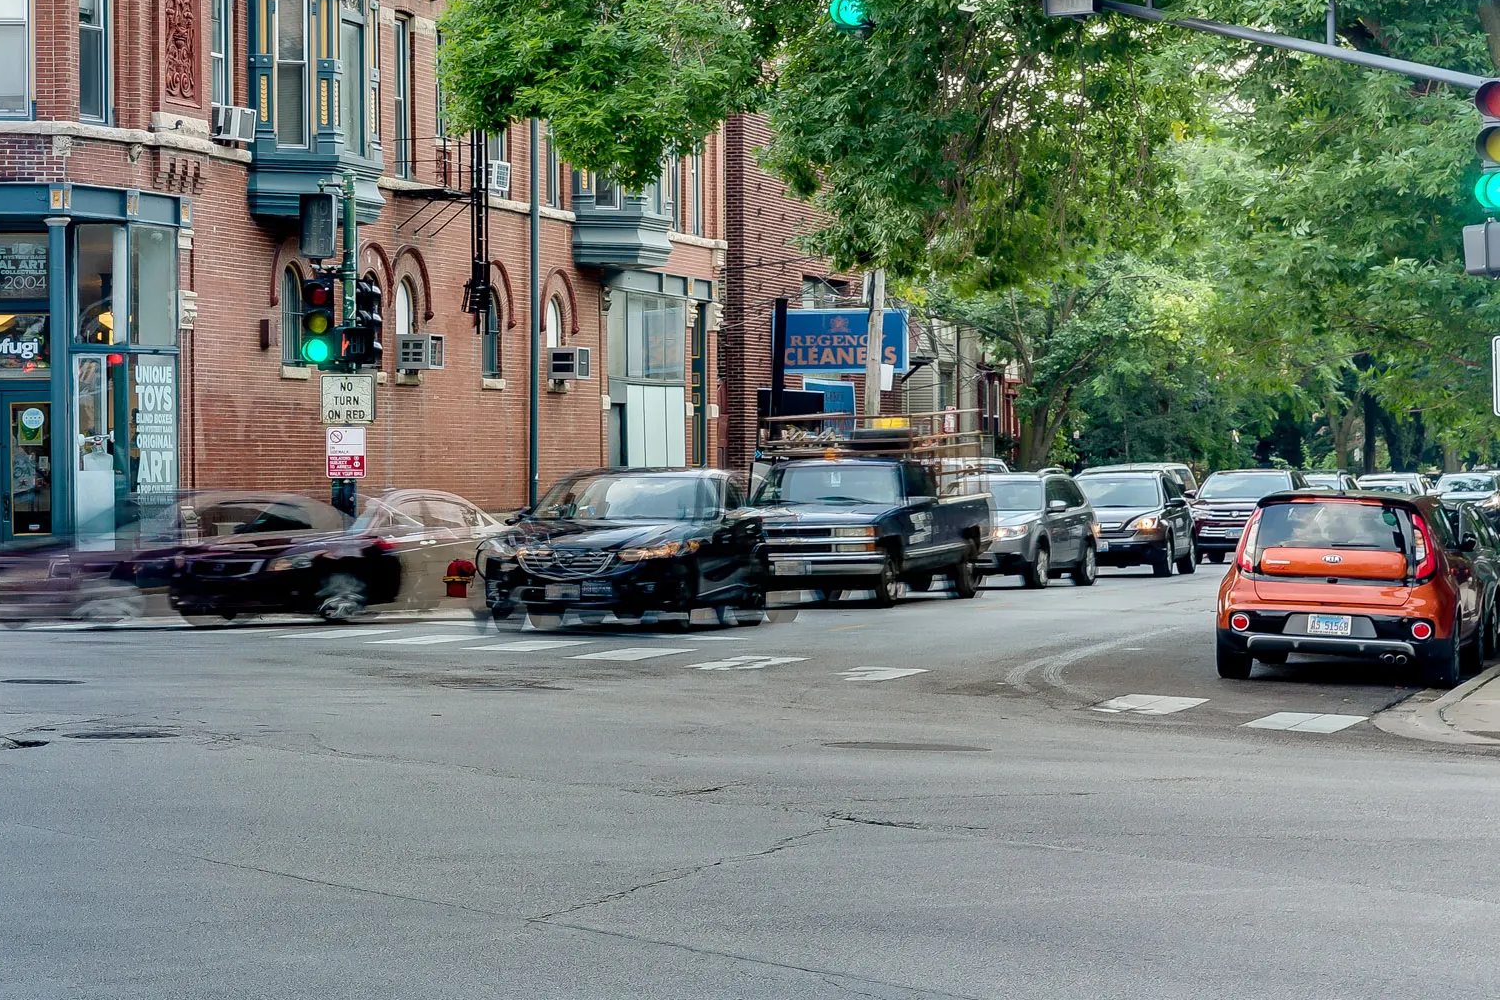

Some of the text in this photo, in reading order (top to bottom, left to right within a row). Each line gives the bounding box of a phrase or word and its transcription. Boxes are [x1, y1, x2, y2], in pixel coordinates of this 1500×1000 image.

[19, 260, 46, 270] ART
[4, 276, 47, 290] 2004
[784, 346, 897, 366] CLEANES
[135, 365, 172, 383] UNIQUE
[340, 382, 353, 391] NO
[135, 384, 172, 412] TOYS
[333, 396, 359, 406] TURN
[136, 413, 173, 424] BLIND BOXES
[328, 410, 365, 420] ON RED
[136, 434, 173, 448] ORIGINAL
[137, 451, 173, 483] ART
